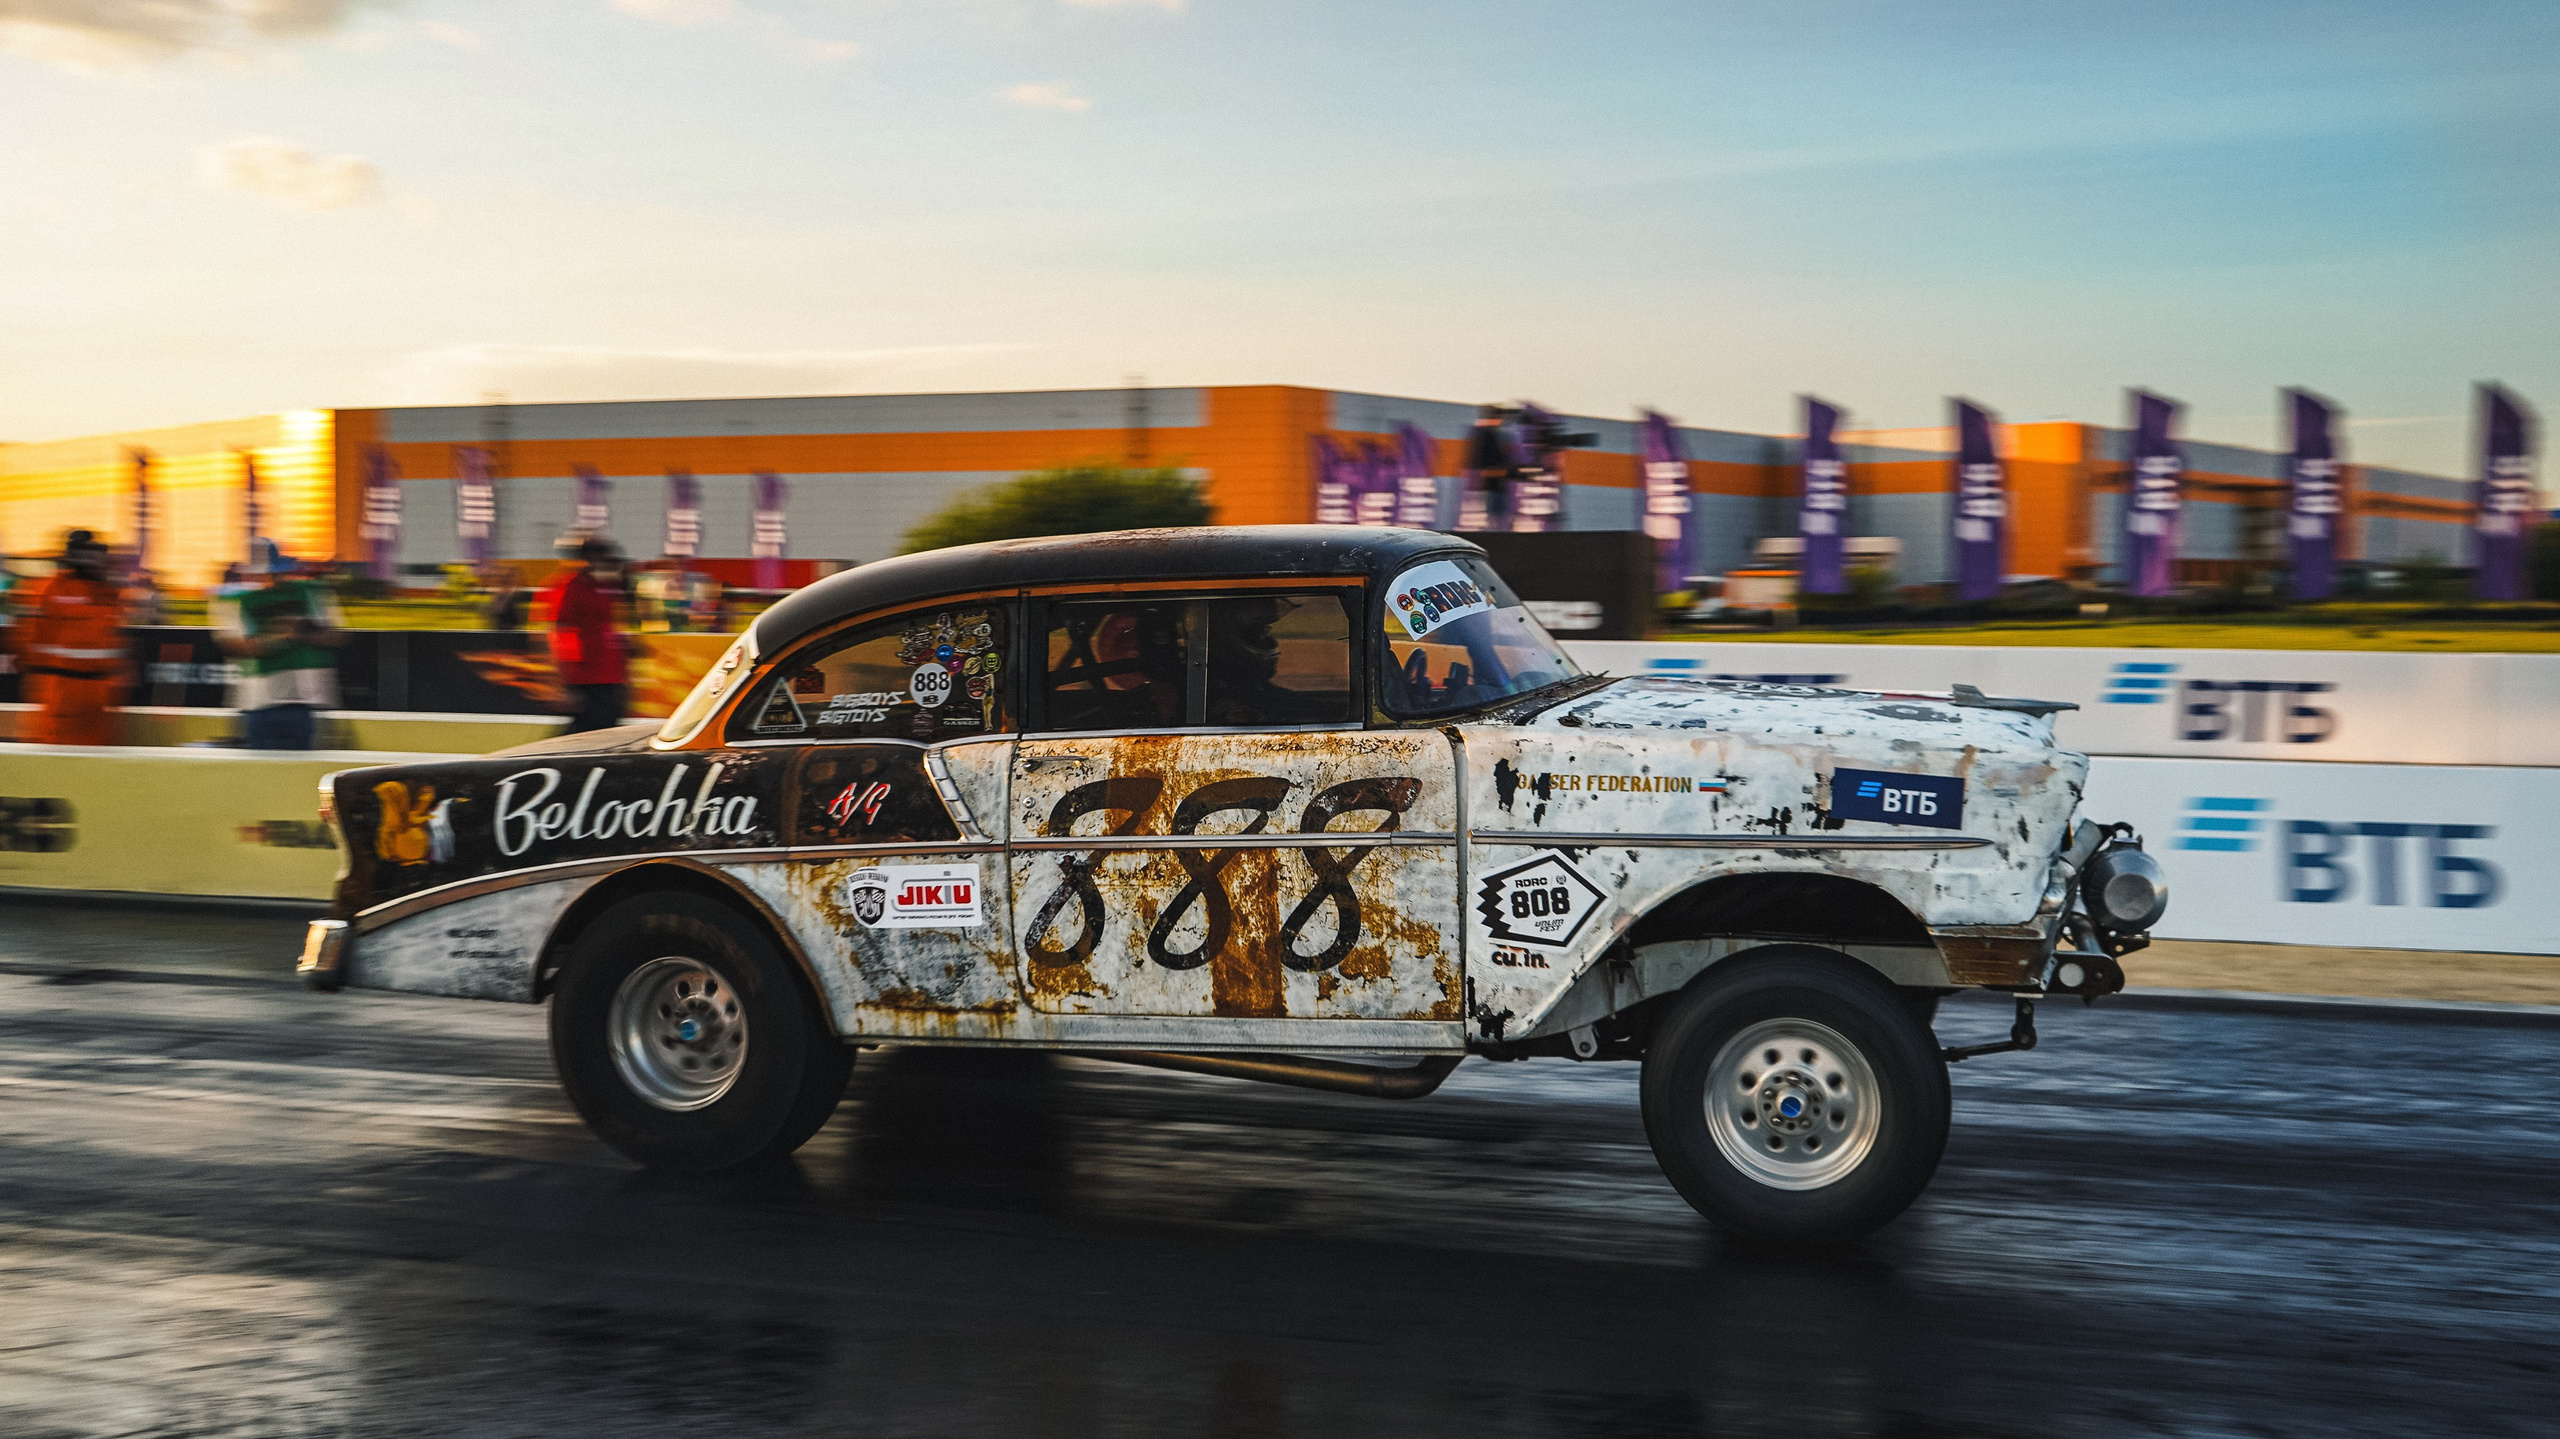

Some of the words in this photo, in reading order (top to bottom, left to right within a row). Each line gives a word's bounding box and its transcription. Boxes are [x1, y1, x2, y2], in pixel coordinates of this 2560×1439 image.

[914, 671, 950, 692] 888
[829, 691, 906, 709] BIGBOYS
[2174, 681, 2341, 743] ВТБ
[815, 707, 890, 725] BIGTOYS
[1517, 773, 1582, 792] GASER
[1587, 774, 1693, 793] FEDERATION
[494, 763, 759, 857] Belochka
[827, 781, 892, 826] A/G
[1882, 787, 1938, 816] ВТБ
[1024, 777, 1423, 972] 888
[2278, 819, 2509, 909] ВТБ
[897, 884, 972, 906] JIKIU
[1514, 876, 1548, 888] RDRC
[1510, 886, 1571, 919] 808
